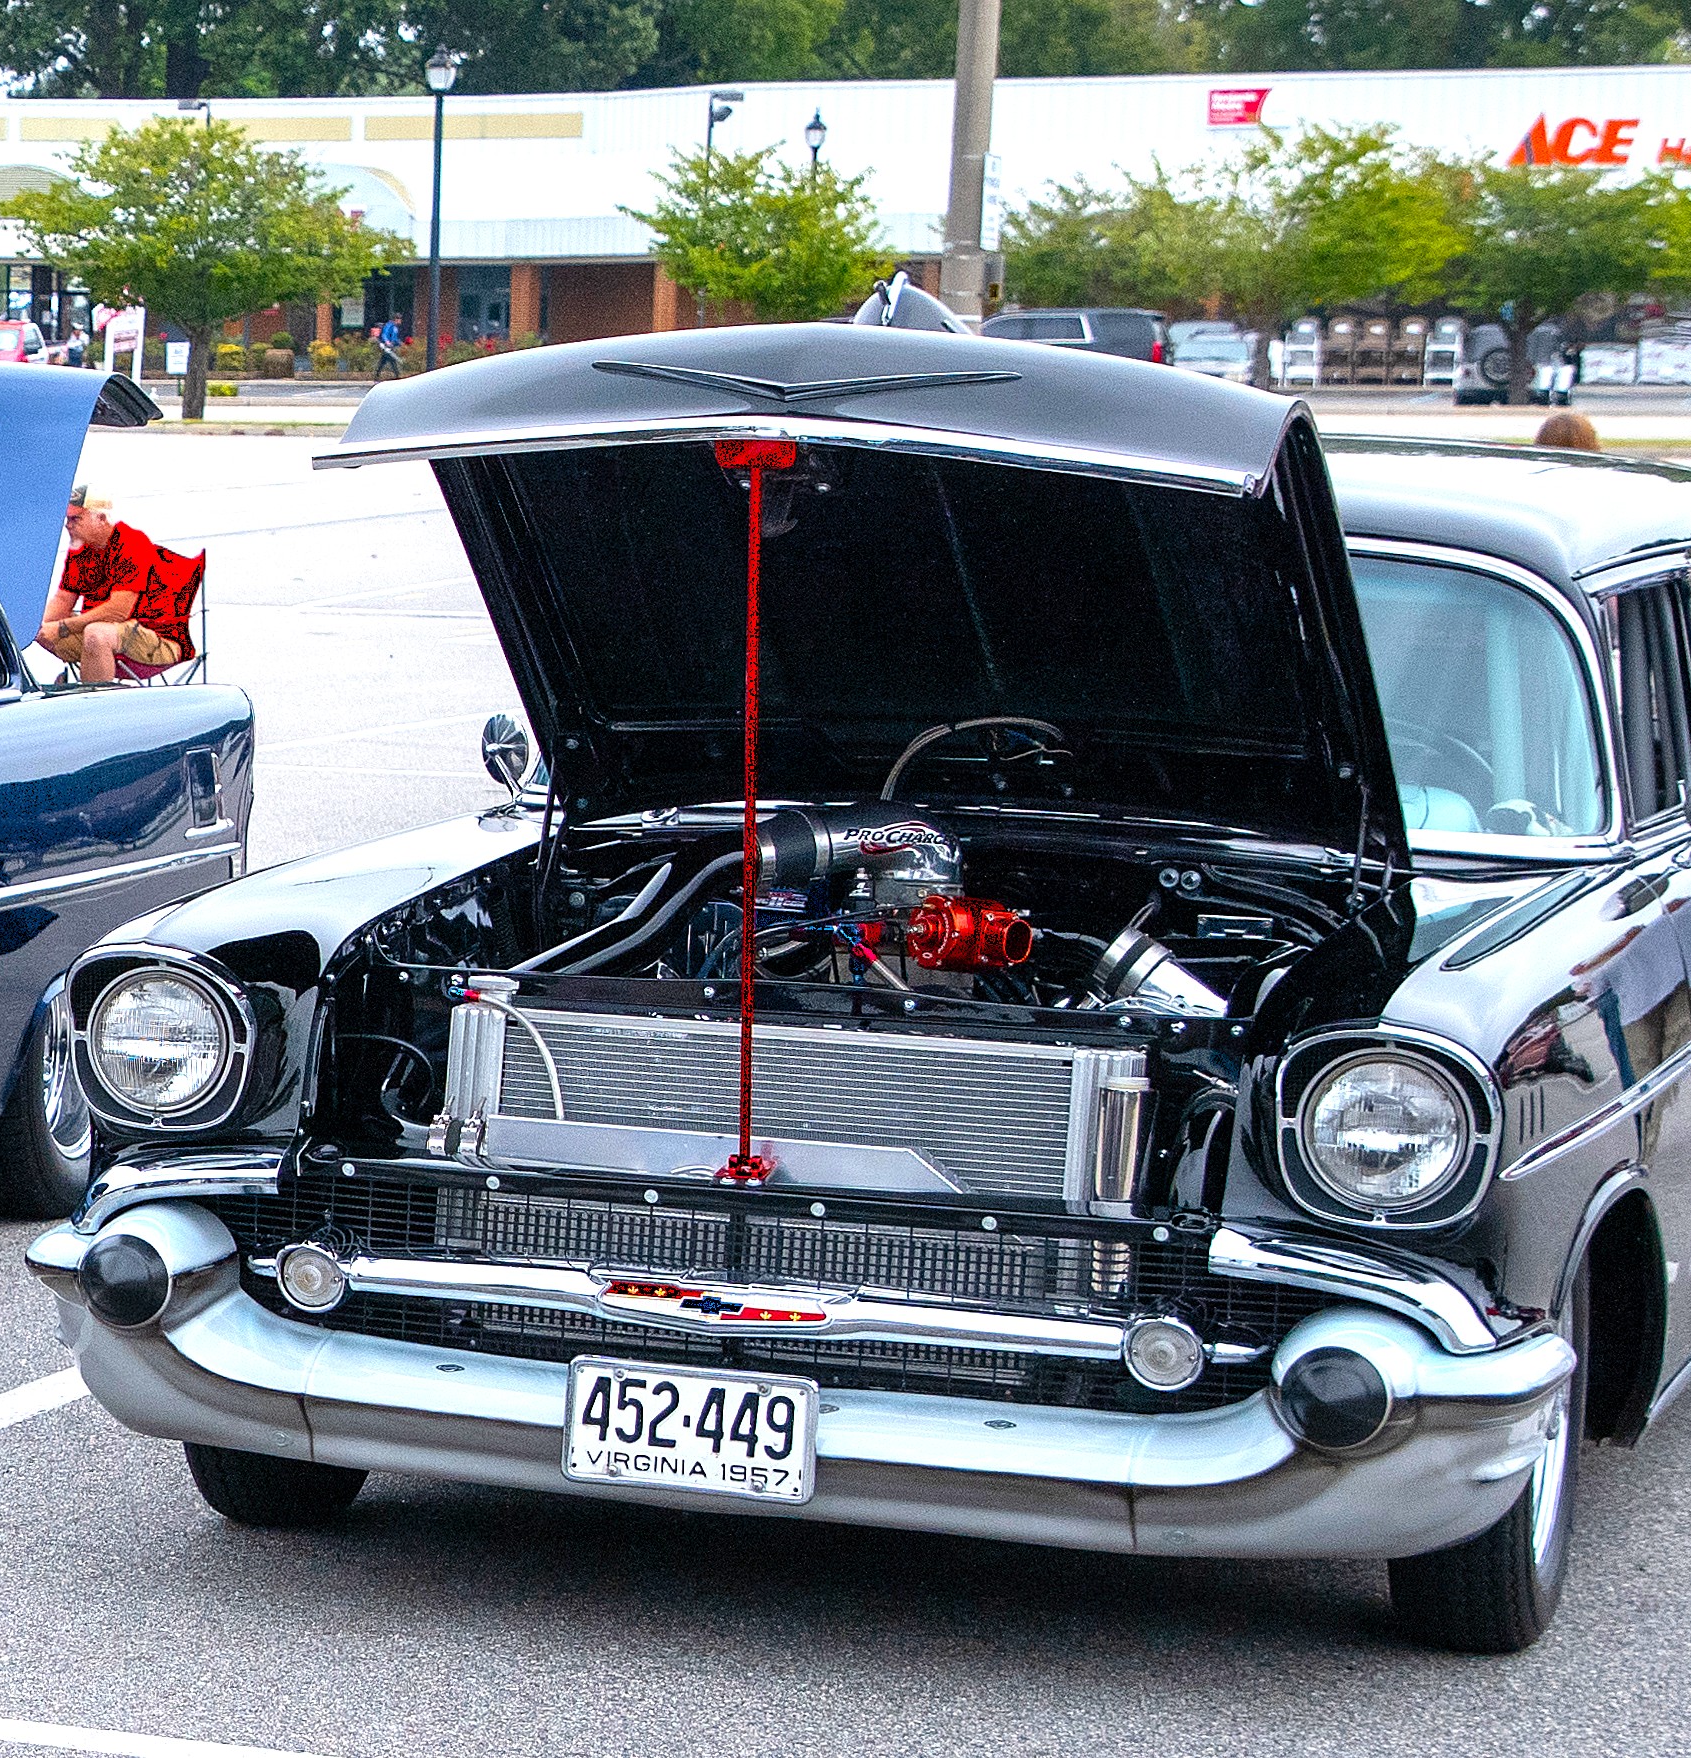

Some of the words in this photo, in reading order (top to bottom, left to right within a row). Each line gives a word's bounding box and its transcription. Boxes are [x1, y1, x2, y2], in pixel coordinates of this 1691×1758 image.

[1506, 112, 1640, 166] ACE
[844, 828, 950, 846] PROCHARG
[587, 1449, 707, 1479] VIRGINIA
[720, 1462, 789, 1487] 1957
